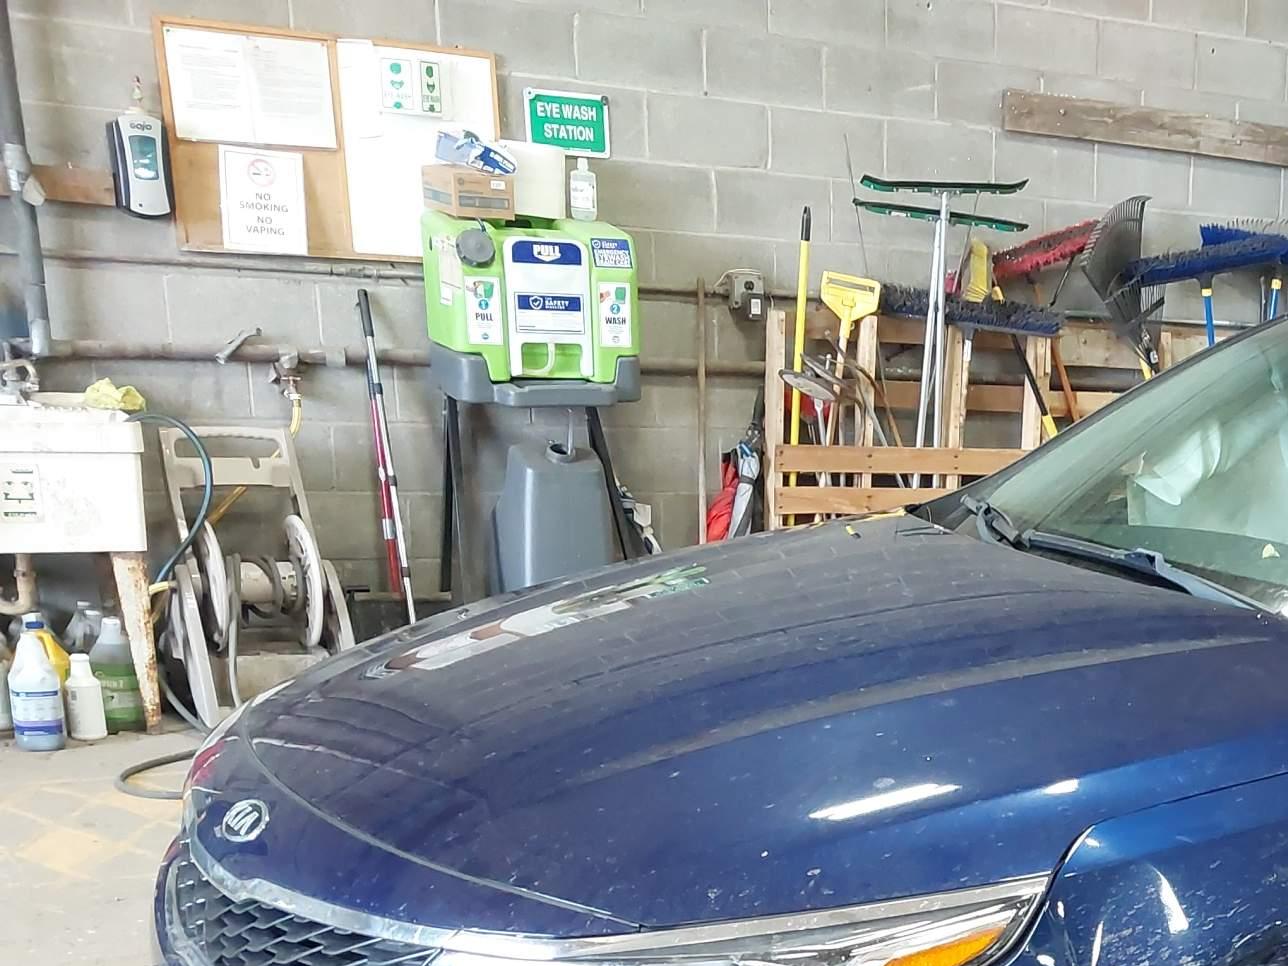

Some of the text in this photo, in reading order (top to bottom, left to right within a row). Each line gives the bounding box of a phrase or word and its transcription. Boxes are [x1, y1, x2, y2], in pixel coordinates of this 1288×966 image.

[537, 102, 597, 121] EYE WASH
[543, 124, 594, 141] STATION
[255, 193, 271, 201] NO
[239, 201, 289, 213] SMOKING
[257, 216, 273, 224] NO
[245, 225, 285, 236] VAPING
[533, 244, 560, 256] PULL
[475, 312, 493, 321] PULL
[605, 316, 627, 326] WASH
